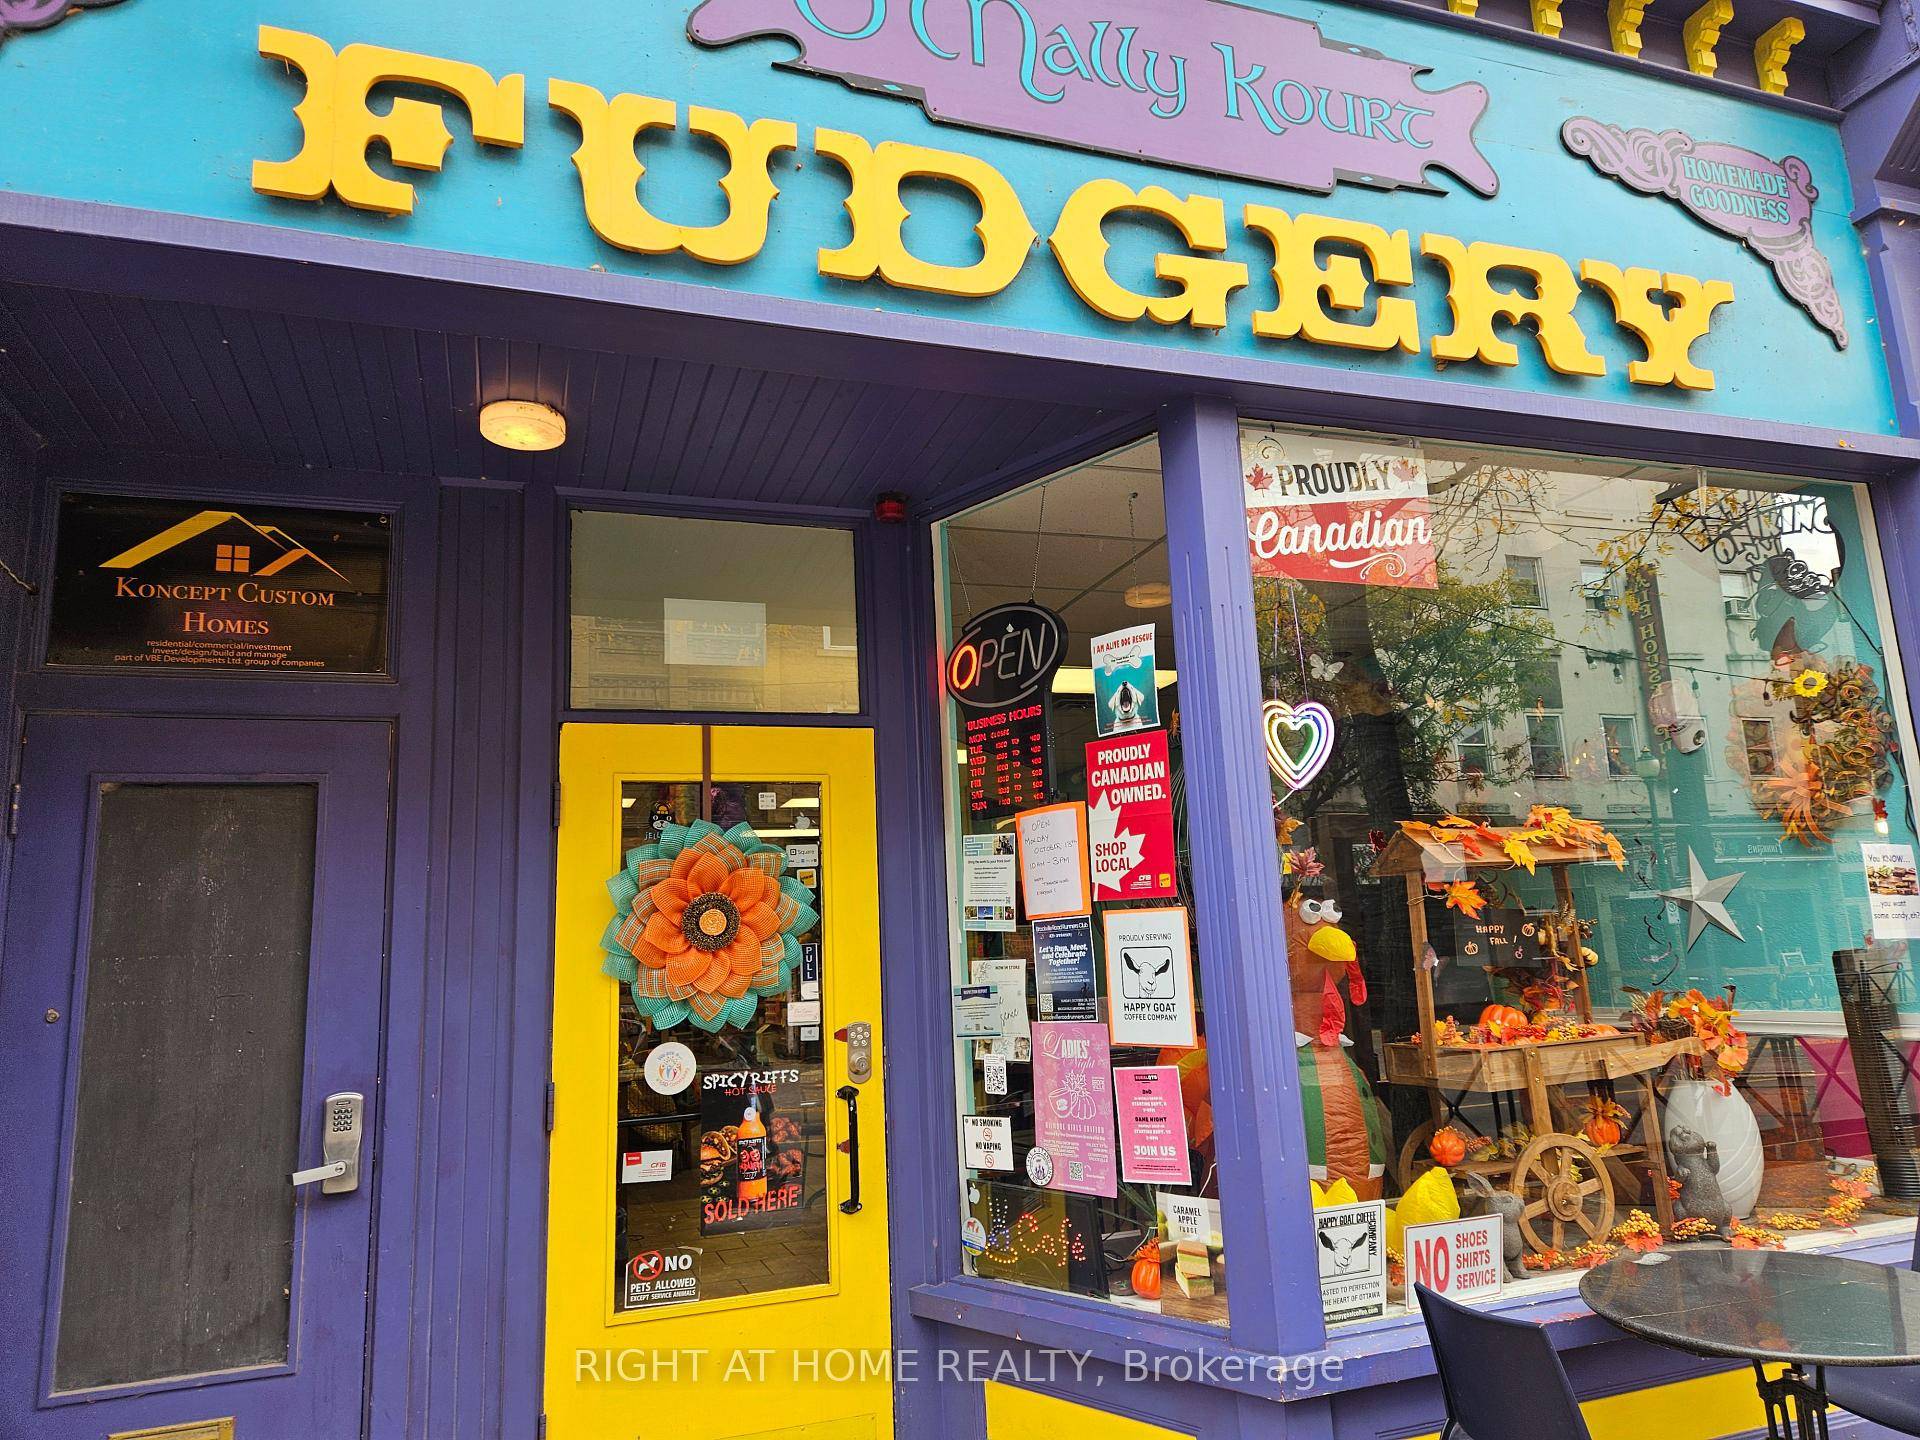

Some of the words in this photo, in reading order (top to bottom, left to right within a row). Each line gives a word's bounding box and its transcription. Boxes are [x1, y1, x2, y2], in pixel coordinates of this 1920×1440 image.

[1681, 156, 1791, 199] HOMEMADE
[251, 24, 1735, 392] FUDGERY
[1690, 184, 1791, 225] GOODNESS
[1277, 460, 1391, 497] PROUDLY
[1247, 510, 1433, 559] Canadian
[146, 639, 293, 652] residential/commercial/investment
[1096, 645, 1105, 654] AM
[1105, 640, 1120, 652] ALIVE
[1121, 637, 1131, 647] DOG
[1132, 632, 1153, 644] RESCUE
[115, 654, 133, 663] part
[135, 654, 145, 662] of
[145, 654, 162, 662] VBE
[163, 655, 226, 665] Developments
[227, 657, 241, 665] Ltd.
[244, 658, 270, 668] group
[280, 659, 325, 668] companies
[152, 647, 234, 659] invest/design/build
[235, 649, 252, 658] and
[253, 651, 288, 661] manage
[952, 623, 1046, 691] OPEN
[967, 713, 1007, 731] BUSINESS
[1009, 704, 1042, 721] HOURS
[968, 733, 987, 744] MON
[969, 745, 983, 755] TUE
[1097, 743, 1151, 766] PROUDLY
[970, 755, 987, 765] WED
[970, 767, 985, 777] THU
[1091, 761, 1165, 787] CANADIAN
[970, 779, 982, 788] FRI
[971, 789, 984, 799] SAT
[1111, 783, 1167, 805] OWNED.
[971, 801, 987, 811] SUN
[1031, 819, 1050, 831] OPEN
[1024, 833, 1049, 846] MONDAY
[1095, 841, 1127, 857] SHOP
[1095, 857, 1133, 873] LOCAL
[1867, 854, 1881, 862] You
[1475, 924, 1504, 934] HAPPY
[1118, 934, 1145, 942] PROUDLY
[1145, 933, 1172, 941] SERVING
[1489, 936, 1508, 945] FALL
[1039, 946, 1054, 954] Let's
[1055, 950, 1086, 960] Celebrate
[804, 945, 814, 981] PULL
[1048, 957, 1080, 967] Together!
[1123, 1002, 1151, 1012] HAPPY
[1153, 1002, 1176, 1012] GOAT
[1124, 1013, 1146, 1021] COFFEE
[1147, 1013, 1178, 1021] COMPANY
[1062, 1057, 1095, 1074] Night
[703, 1070, 749, 1090] SPICY
[749, 1069, 800, 1085] RIFFS
[724, 1087, 747, 1096] HOT
[971, 1118, 979, 1127] NO
[979, 1119, 1003, 1128] SMOKING
[975, 1141, 982, 1150] NO
[982, 1141, 1002, 1151] VAPING
[1133, 1145, 1158, 1156] JOIN
[1160, 1145, 1177, 1157] US
[703, 1198, 750, 1225] SOLD
[754, 1184, 799, 1215] HERE
[1172, 1205, 1202, 1217] CARAMEL
[1178, 1215, 1198, 1226] APPLE
[1318, 1216, 1338, 1230] HAPPY
[1339, 1214, 1355, 1227] GOAT
[1356, 1211, 1377, 1224] COFFEE
[1368, 1221, 1378, 1257] COMPANY
[1455, 1229, 1488, 1250] SHOES
[664, 1254, 693, 1272] NO
[1414, 1236, 1450, 1294] NO
[1455, 1249, 1491, 1270] SHIRTS
[630, 1282, 651, 1294] PETS
[655, 1277, 696, 1291] ALLOWED
[1456, 1268, 1496, 1291] SERVICE
[630, 1294, 650, 1302] EXCEPT
[651, 1292, 672, 1300] SERVICE
[672, 1289, 696, 1298] ANIMALS
[1322, 1287, 1340, 1297] ASTED
[1340, 1286, 1348, 1294] TO
[1348, 1281, 1380, 1293] PERFECTION
[1332, 1296, 1350, 1306] HEART
[1351, 1294, 1359, 1303] OF
[1359, 1291, 1381, 1302] OTTAWA
